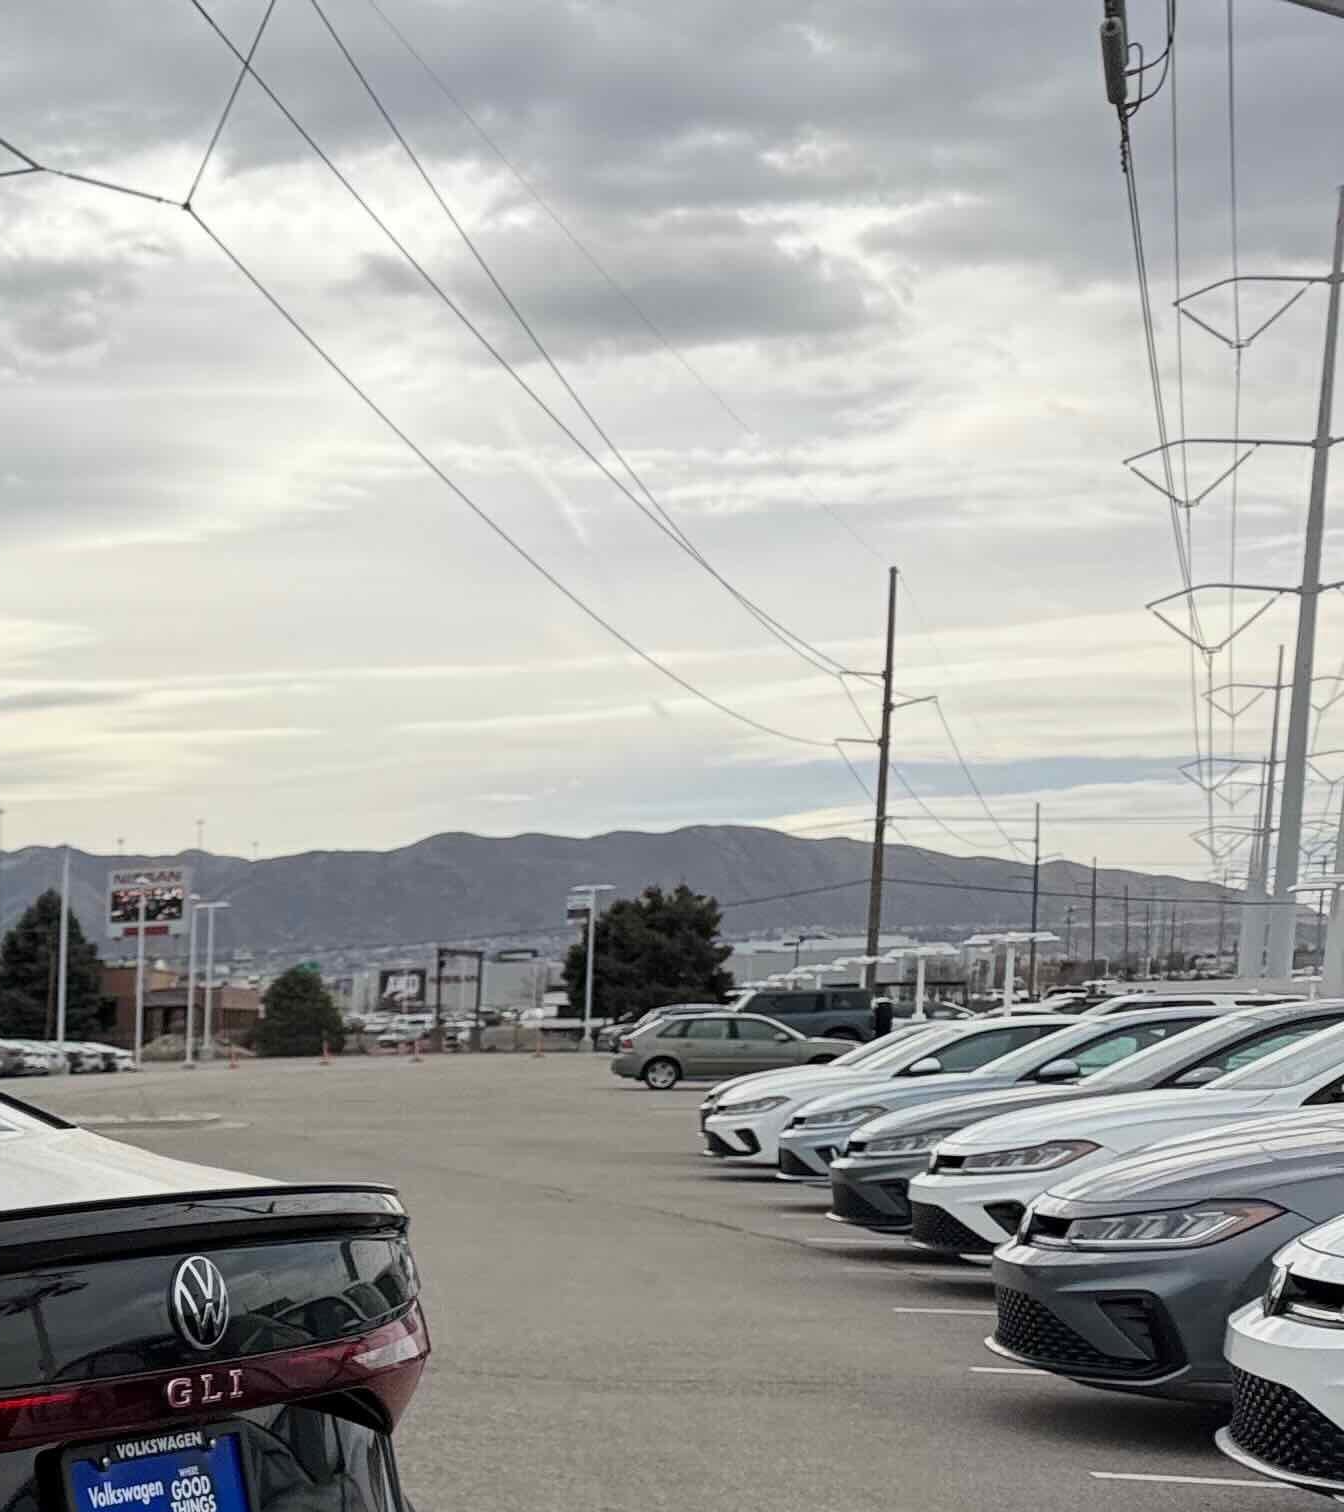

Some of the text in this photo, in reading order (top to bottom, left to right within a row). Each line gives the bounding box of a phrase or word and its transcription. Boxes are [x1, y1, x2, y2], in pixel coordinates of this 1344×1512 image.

[167, 1370, 244, 1408] GLI
[116, 1431, 203, 1459] VOLKSWAGEN
[88, 1480, 164, 1508] Volkswagen
[171, 1475, 211, 1500] GOOD
